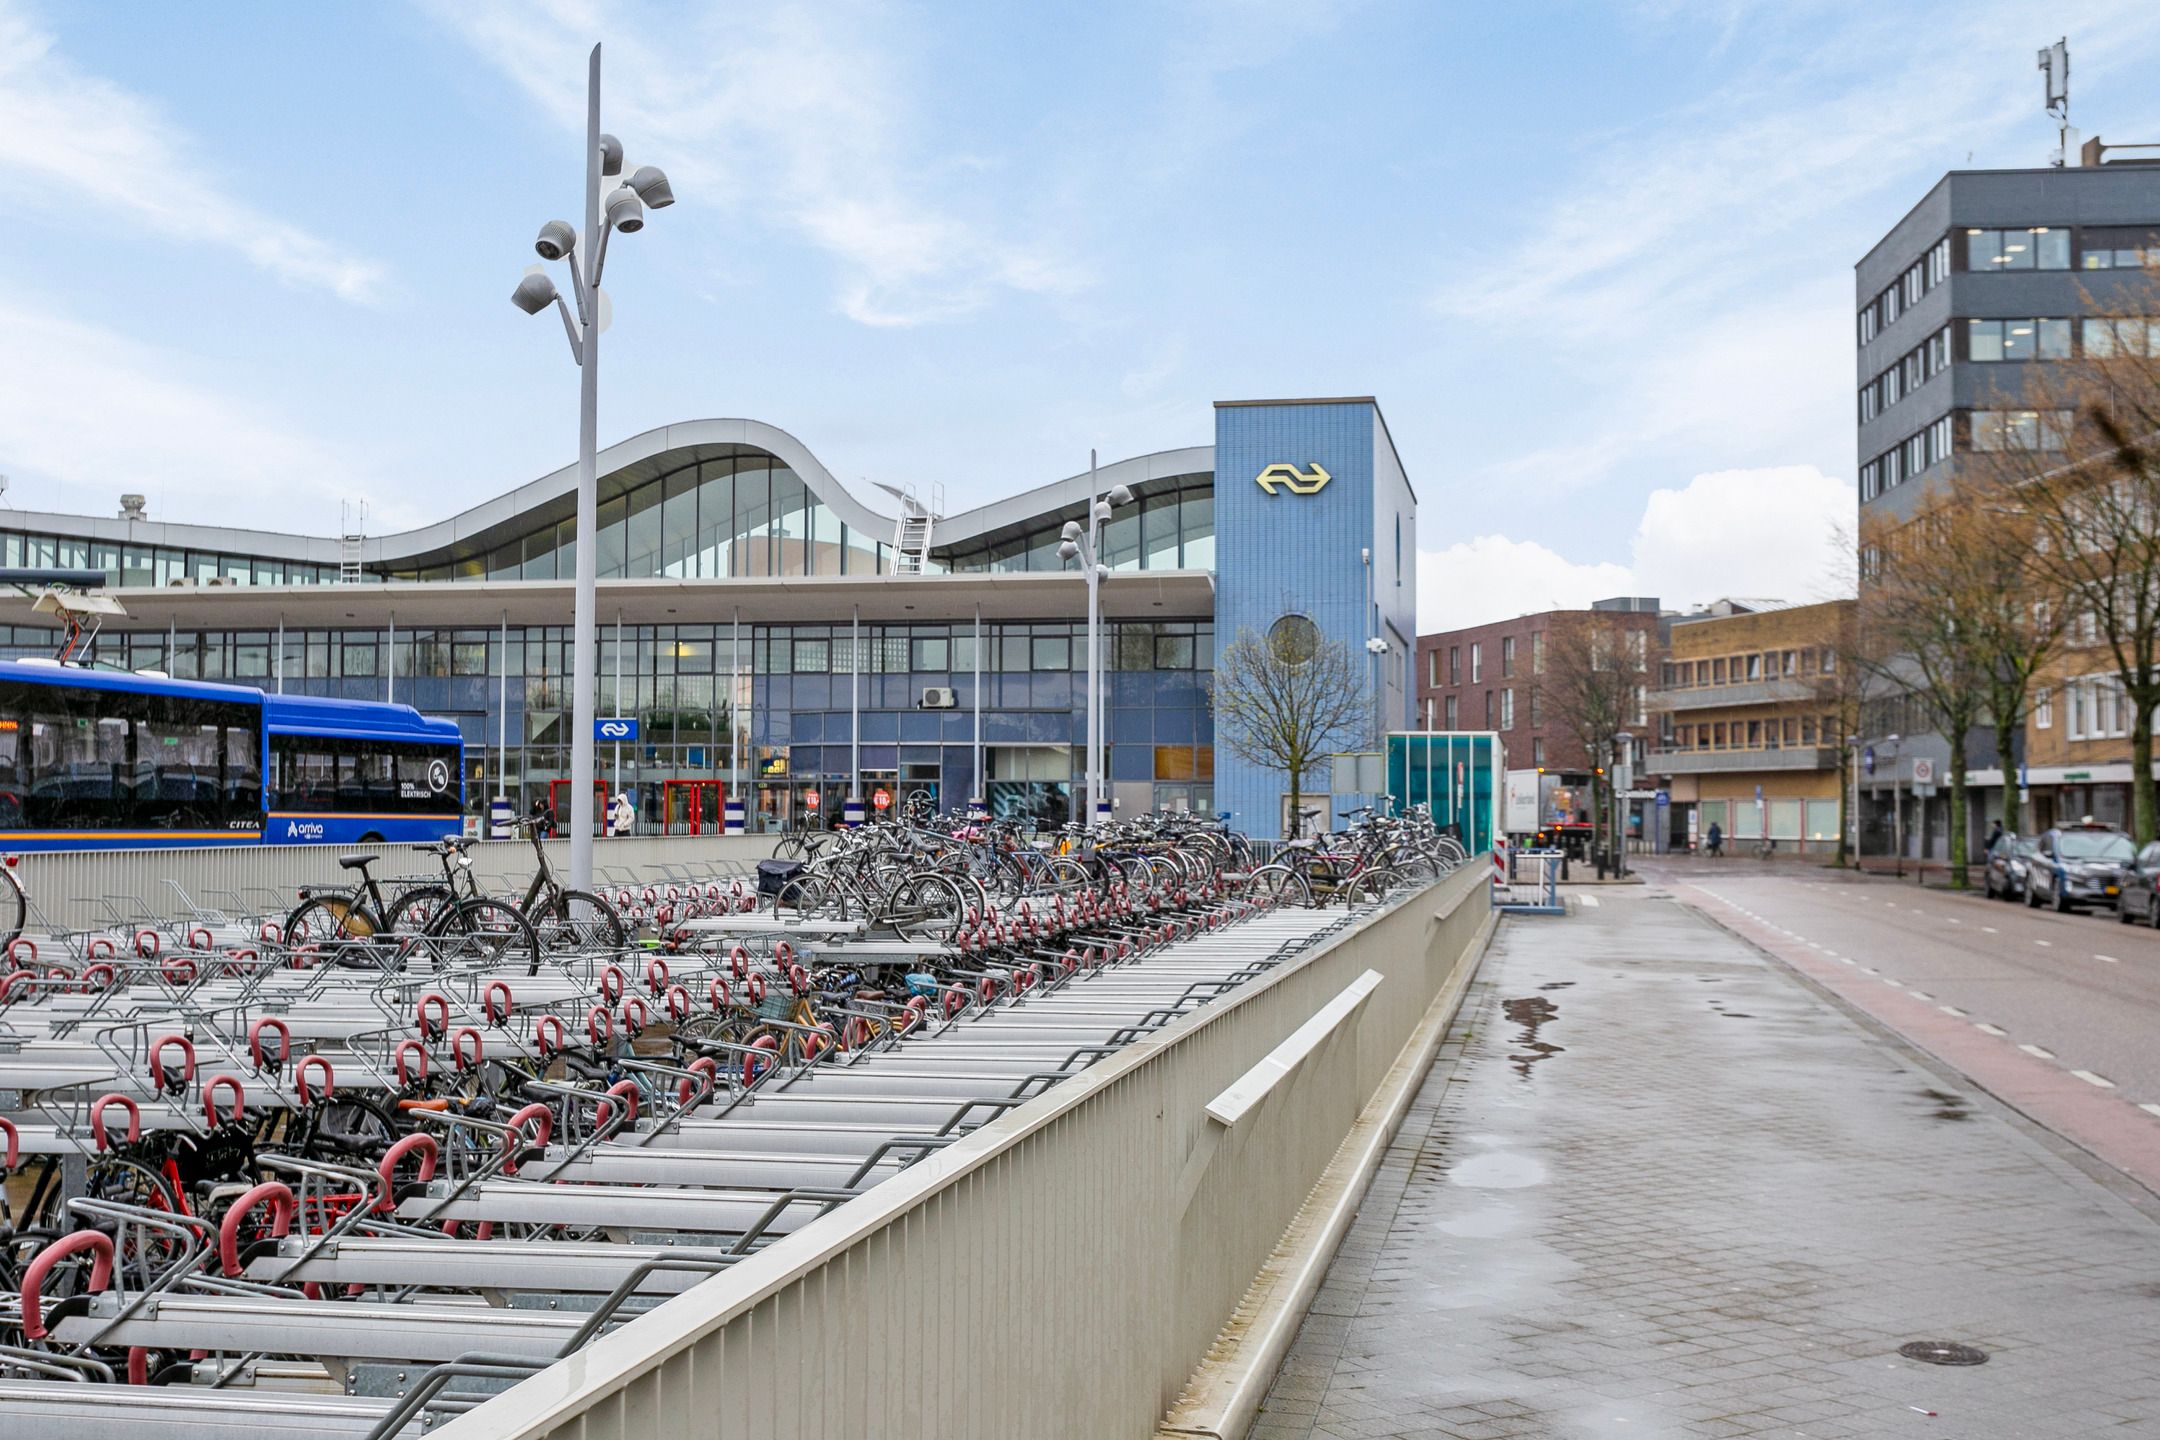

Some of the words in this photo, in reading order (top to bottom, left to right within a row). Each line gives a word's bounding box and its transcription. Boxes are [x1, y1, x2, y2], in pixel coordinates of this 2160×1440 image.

[401, 790, 431, 798] ELEKTRISCH
[229, 820, 260, 829] CITEA
[298, 822, 323, 834] arriva
